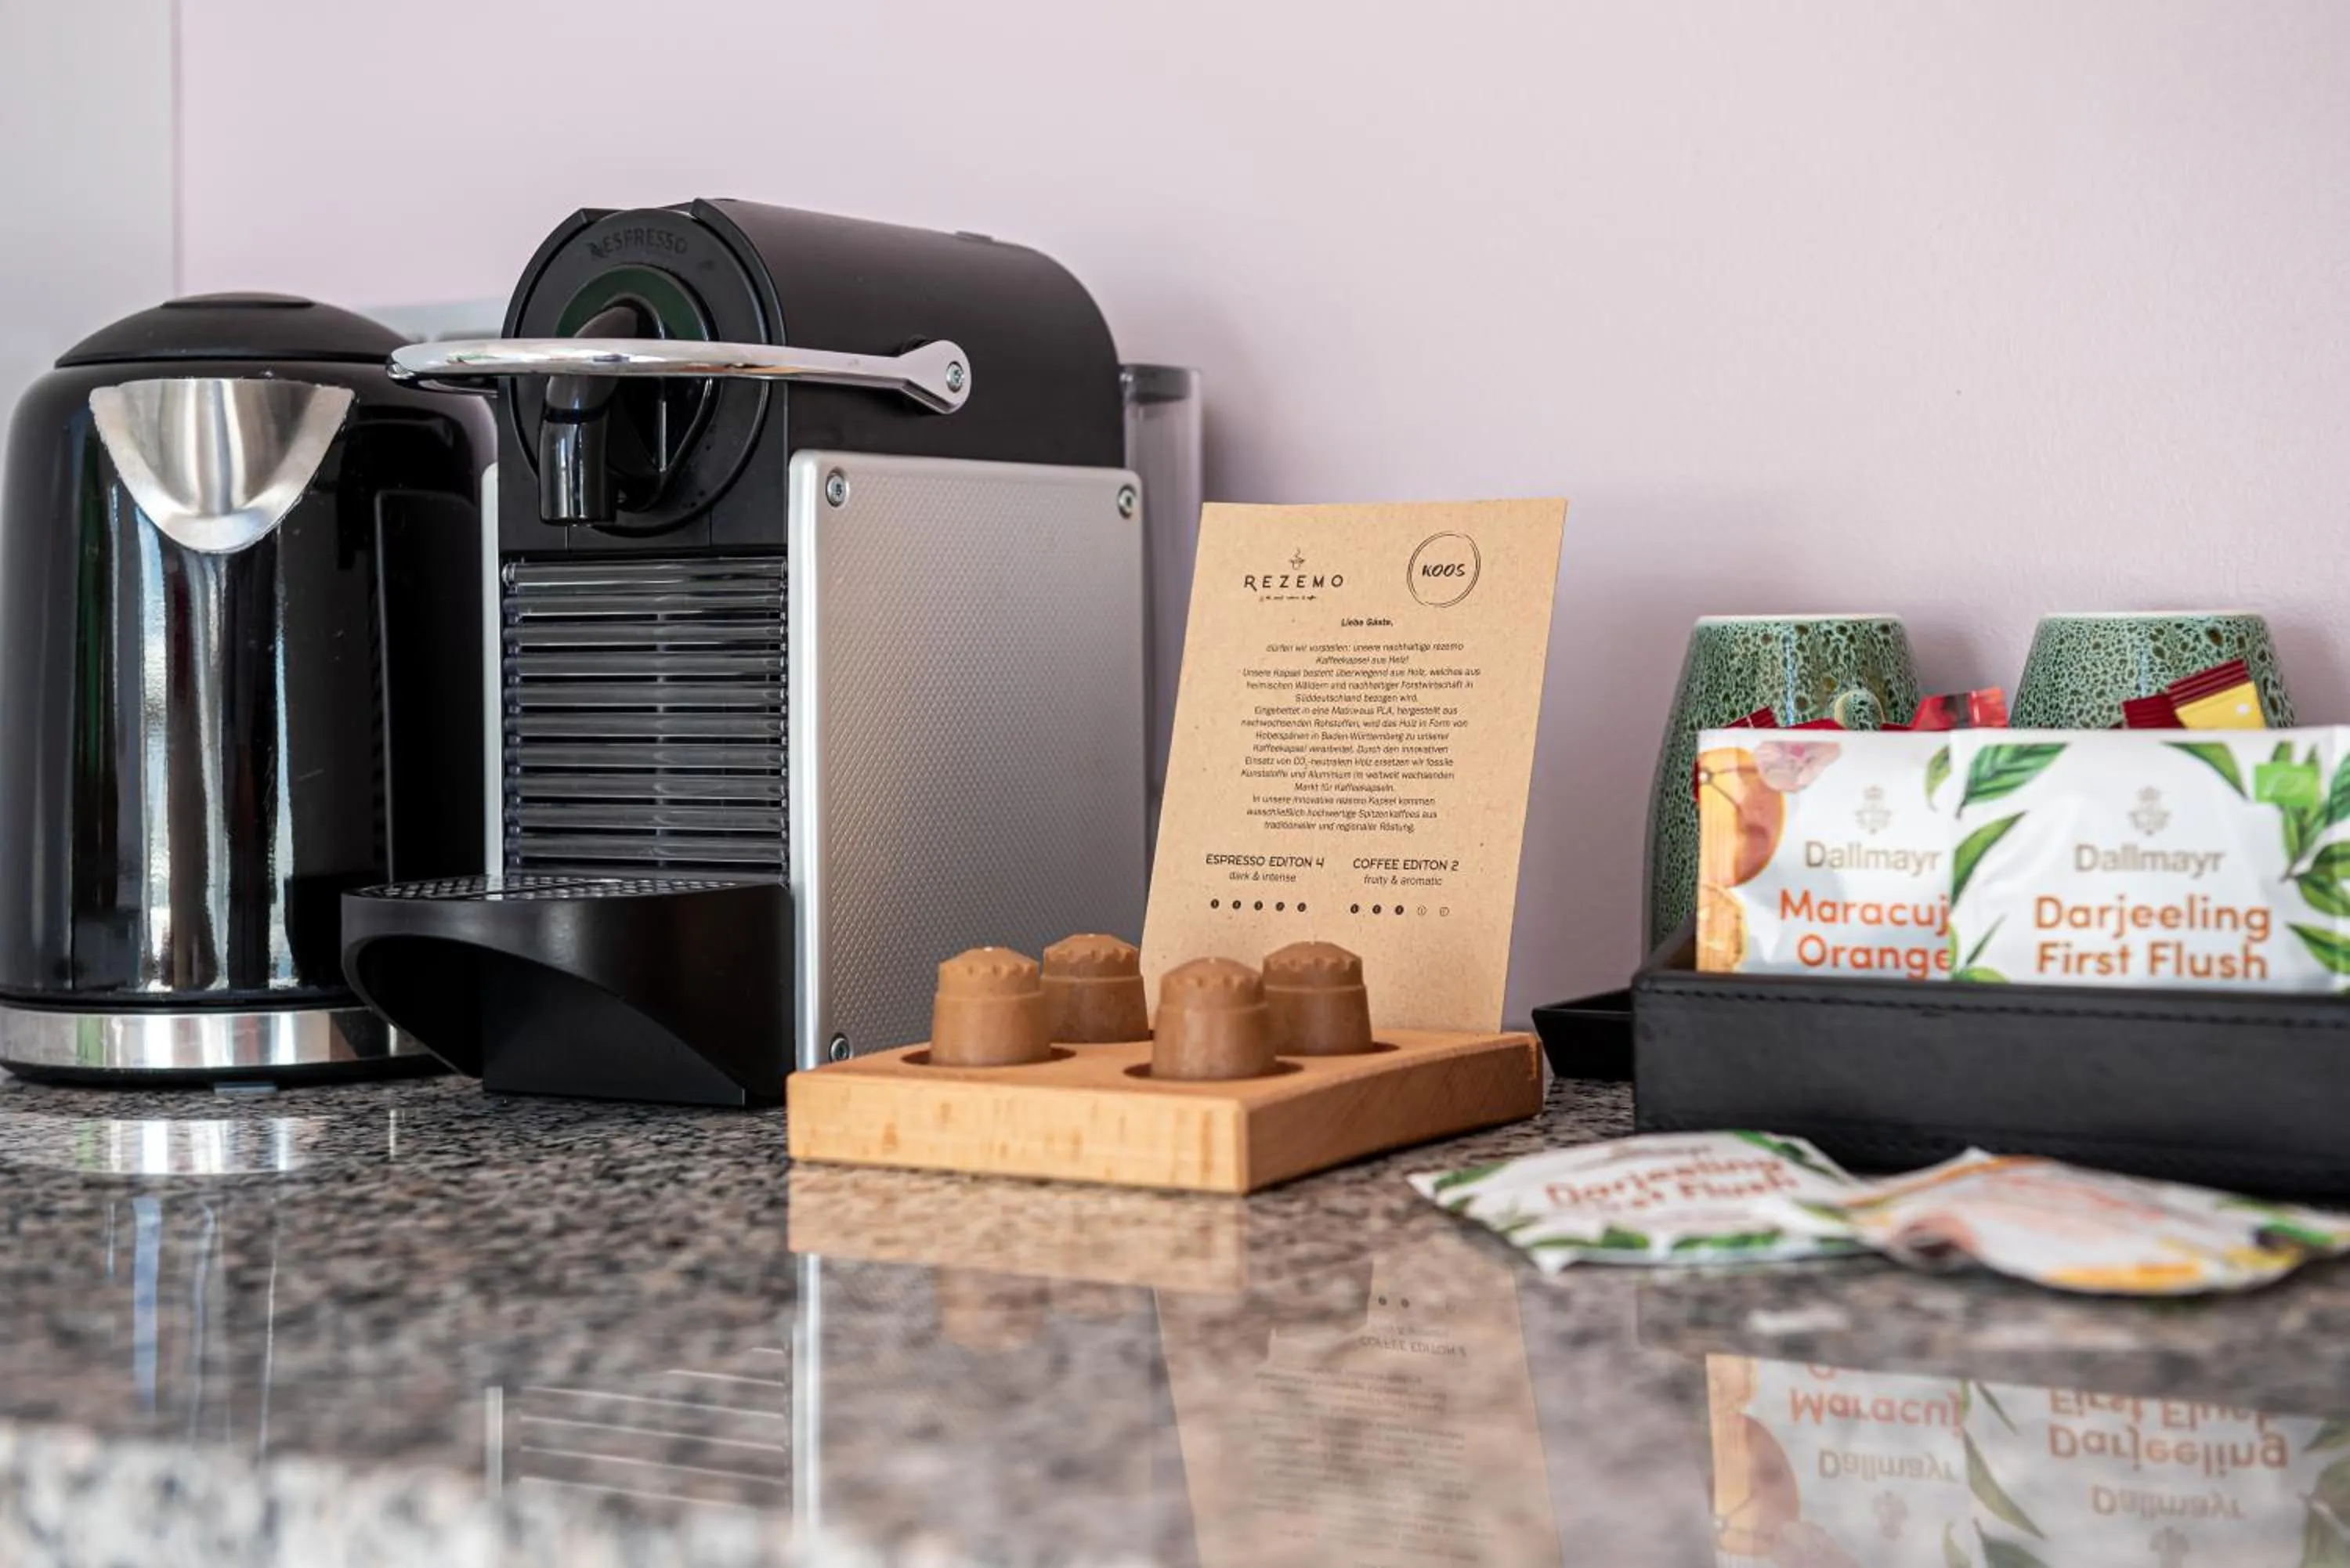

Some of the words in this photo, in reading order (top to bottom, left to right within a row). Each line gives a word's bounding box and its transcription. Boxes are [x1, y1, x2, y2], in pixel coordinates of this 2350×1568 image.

[589, 228, 688, 258] NESPRESSO
[1422, 563, 1466, 577] KOOS
[1244, 574, 1344, 592] REZEMO
[1341, 618, 1364, 627] Liebe
[1366, 618, 1394, 627] Gäste,
[1242, 668, 1271, 677] Unsere
[1430, 668, 1462, 677] welches
[1247, 681, 1292, 690] heimischen
[1331, 681, 1346, 690] und
[1365, 694, 1397, 704] bezogen
[1397, 706, 1440, 717] hergestellt
[1363, 719, 1380, 728] wird
[1382, 719, 1397, 728] das
[1419, 719, 1426, 728] in
[1429, 719, 1451, 728] Form
[1383, 745, 1399, 753] den
[1246, 757, 1274, 765] Einsatz
[1374, 757, 1409, 766] ersetzen
[1412, 757, 1424, 767] wir
[1426, 757, 1454, 767] fossile
[1291, 769, 1305, 778] und
[1308, 770, 1350, 779] Aluminium
[1366, 770, 1399, 779] weltweit
[1294, 783, 1319, 792] Markt
[1321, 783, 1332, 792] für
[1398, 797, 1435, 805] kommen
[1319, 822, 1333, 830] und
[1206, 854, 1265, 866] ESPRESSO
[1315, 858, 1325, 869] 4
[1805, 840, 1942, 876] Dallmayr
[2076, 844, 2225, 878] Dallmayr
[1353, 858, 1398, 870] COFFEE
[1451, 861, 1459, 872] 2
[1229, 871, 1249, 880] dark
[1253, 872, 1260, 880] &
[1262, 873, 1296, 882] intense
[1364, 875, 1388, 886] fruity
[1390, 876, 1398, 885] &
[1401, 876, 1443, 886] aromatic
[1780, 887, 1951, 936] Maracuj
[2034, 894, 2270, 942] Darjeeling
[1798, 934, 1950, 981] Orange
[2038, 941, 2131, 975] First
[2149, 941, 2269, 979] Flush
